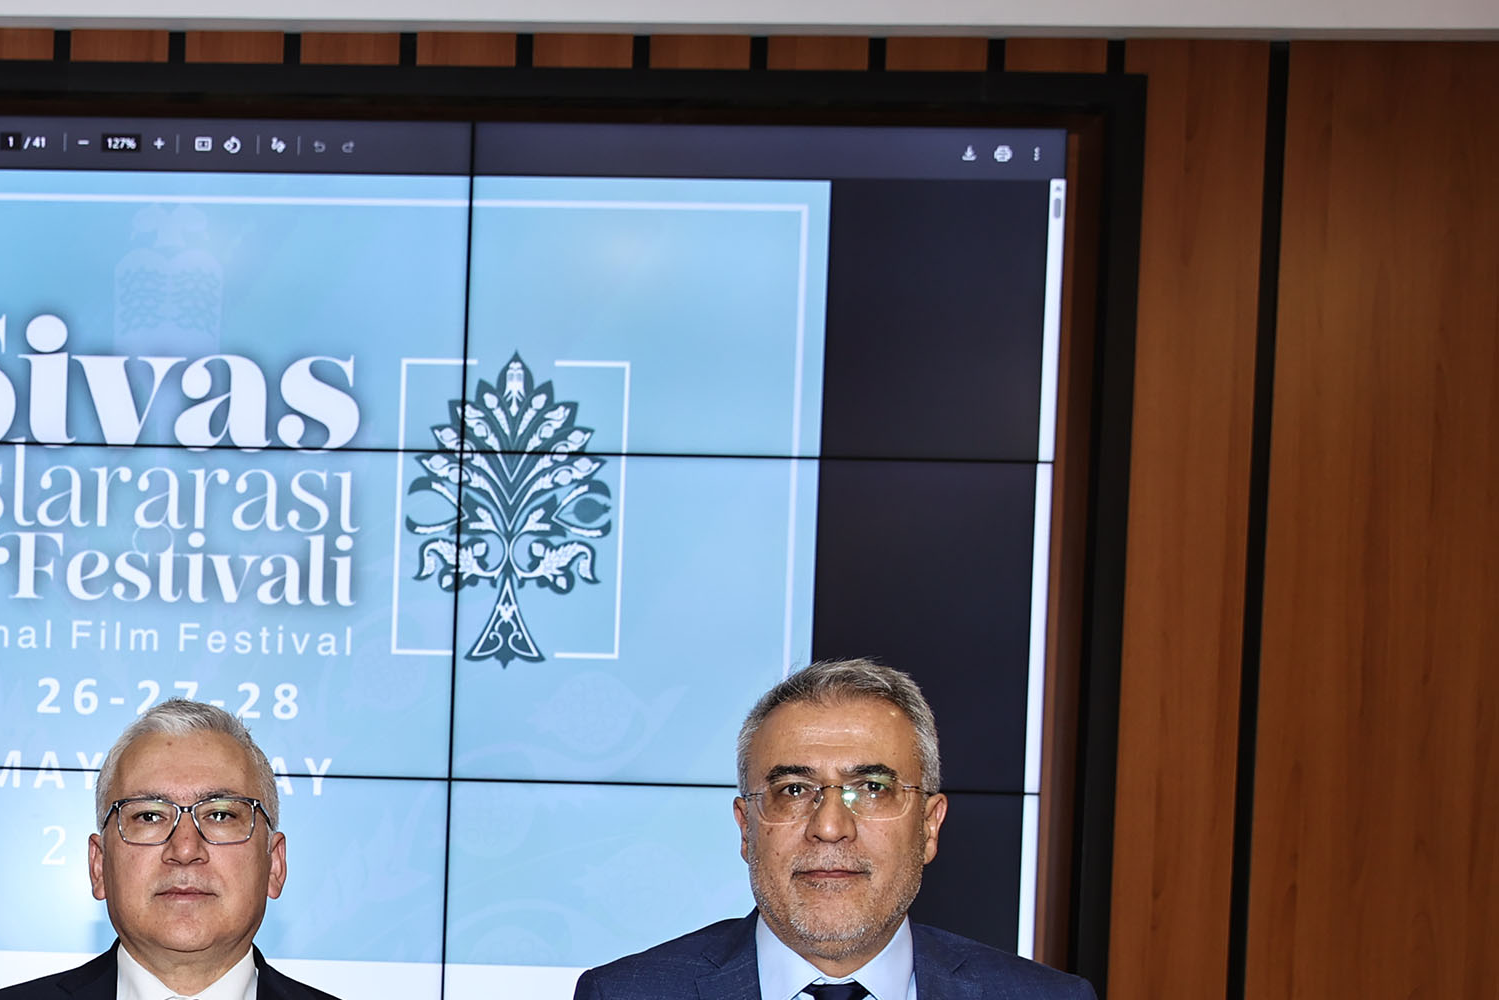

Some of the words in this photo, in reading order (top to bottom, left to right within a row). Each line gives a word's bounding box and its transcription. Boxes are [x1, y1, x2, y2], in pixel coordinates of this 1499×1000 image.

[106, 137, 137, 150] 127%
[71, 620, 159, 651] Film
[178, 623, 353, 657] Festival
[270, 756, 333, 797] AY
